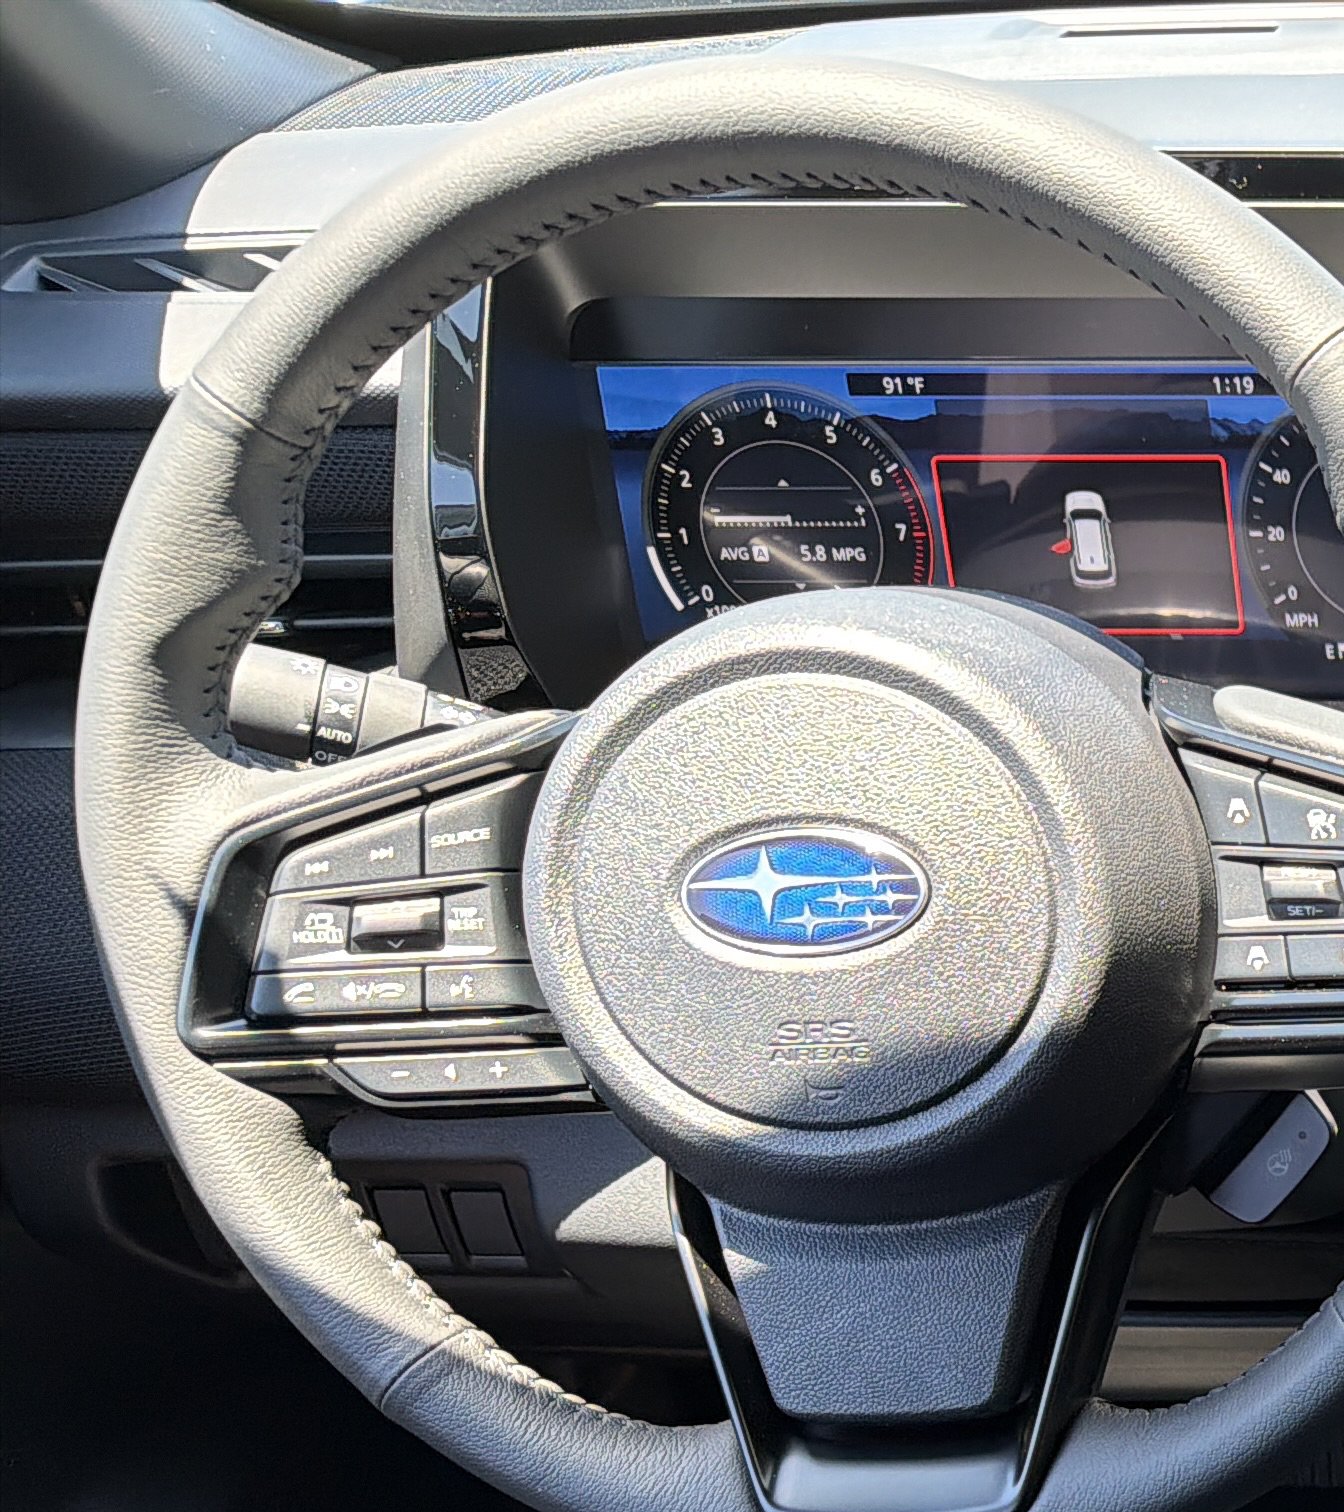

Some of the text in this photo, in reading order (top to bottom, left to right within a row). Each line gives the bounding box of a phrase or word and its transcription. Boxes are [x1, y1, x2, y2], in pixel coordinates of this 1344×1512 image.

[1212, 376, 1254, 395] 1:19
[764, 411, 778, 428] 4
[713, 428, 725, 446] 3
[824, 427, 838, 444] 5
[680, 470, 693, 488] 2
[870, 469, 884, 487] 6
[1272, 468, 1291, 485] 40
[678, 527, 690, 545] 1
[894, 524, 908, 542] 7
[1267, 525, 1285, 543] 20
[720, 547, 750, 562] AVG
[800, 543, 827, 561] 5.8
[832, 547, 867, 562] MPG
[701, 584, 714, 602] 0
[1287, 586, 1298, 601] 0
[1285, 613, 1319, 628] MPH
[1325, 644, 1336, 660] E
[316, 726, 353, 744] AUTO
[430, 827, 491, 849] SOURCE
[772, 1020, 852, 1042] SRS
[768, 1047, 871, 1065] AIRBAG
